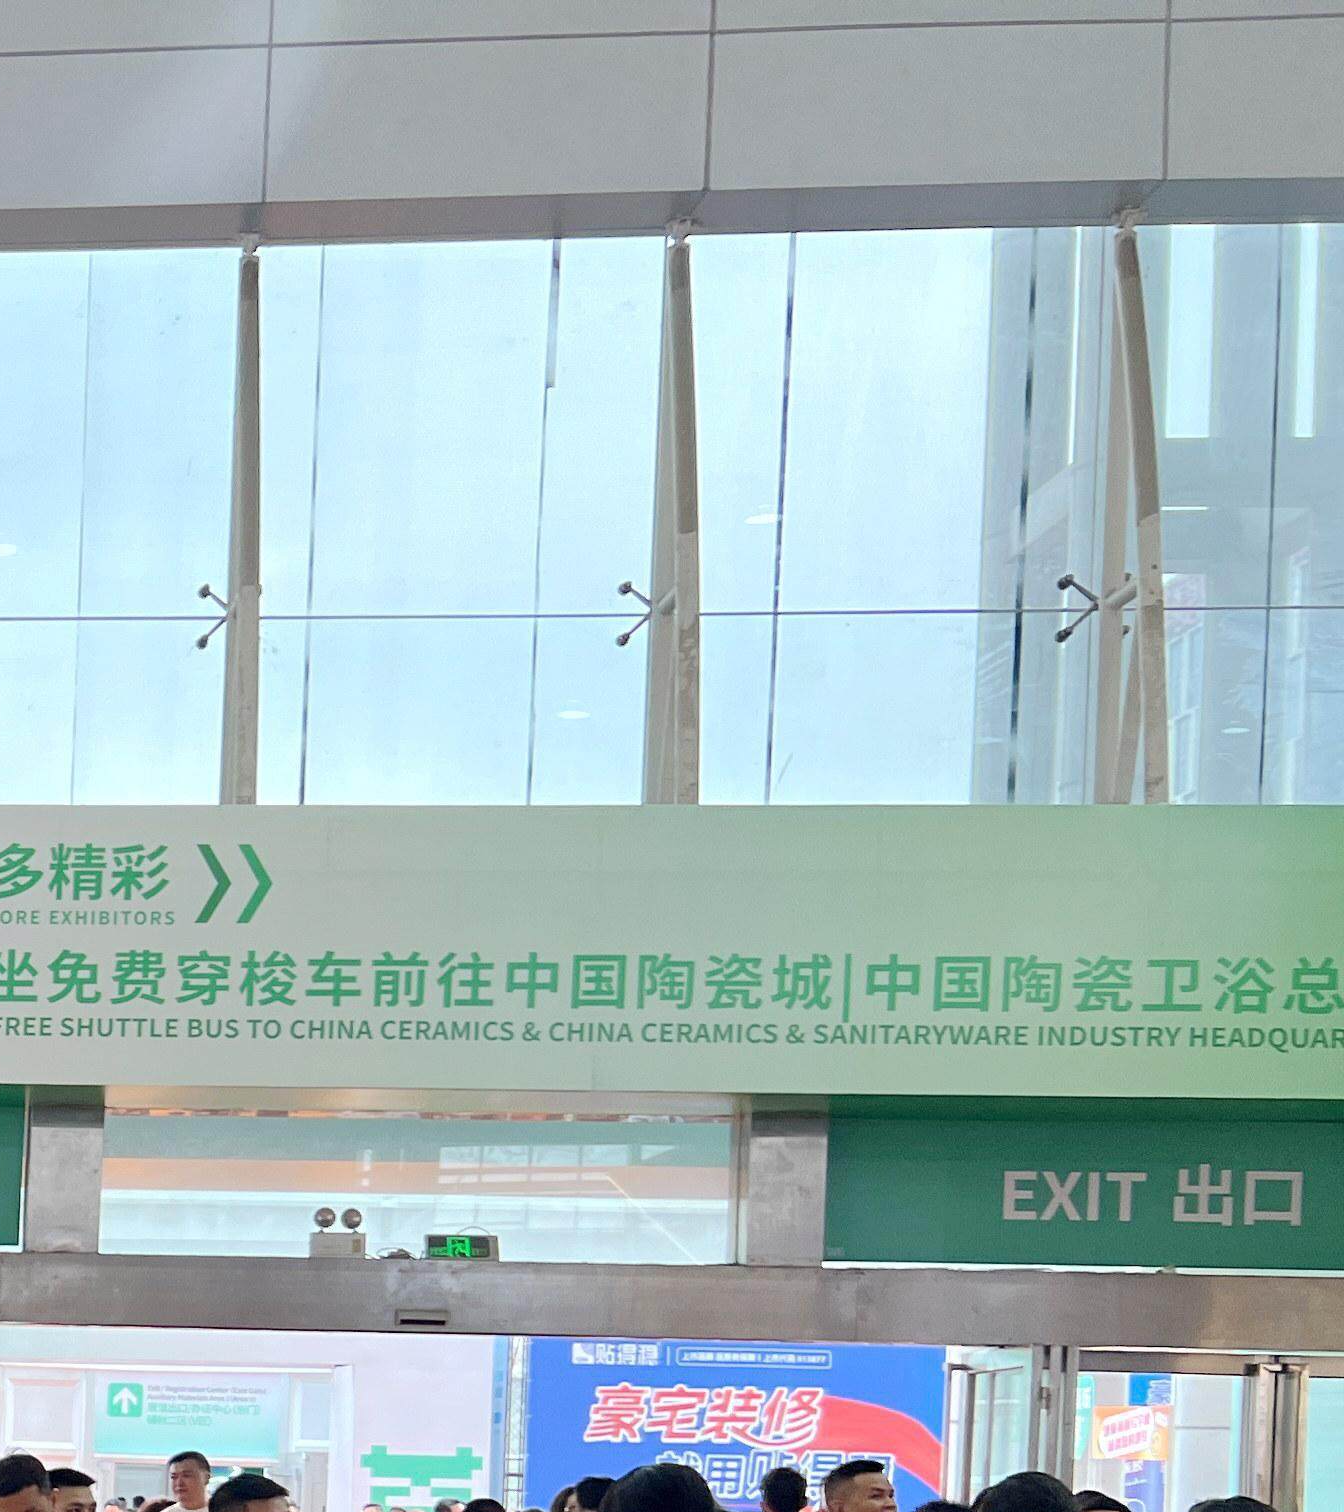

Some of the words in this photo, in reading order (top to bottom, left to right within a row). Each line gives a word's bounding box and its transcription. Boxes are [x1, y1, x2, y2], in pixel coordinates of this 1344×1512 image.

[48, 910, 176, 926] EXHIBITORS
[60, 1017, 179, 1039] SHUTTLE
[186, 1018, 240, 1040] BUS
[246, 1018, 283, 1040] TO
[289, 1018, 372, 1041] CHINA
[379, 1019, 514, 1042] CERAMICS
[521, 1020, 542, 1042] &
[548, 1021, 633, 1043] CHINA
[640, 1023, 778, 1044] CERAMICS
[785, 1024, 806, 1044] &
[813, 1024, 1029, 1046] SANITARYWARE
[1037, 1026, 1182, 1048] INDUSTRY
[1189, 1027, 1344, 1052] HEADQUAR
[1002, 1170, 1148, 1222] EXIT
[1172, 1163, 1304, 1227] 出口
[583, 1381, 825, 1450] 豪宅装修
